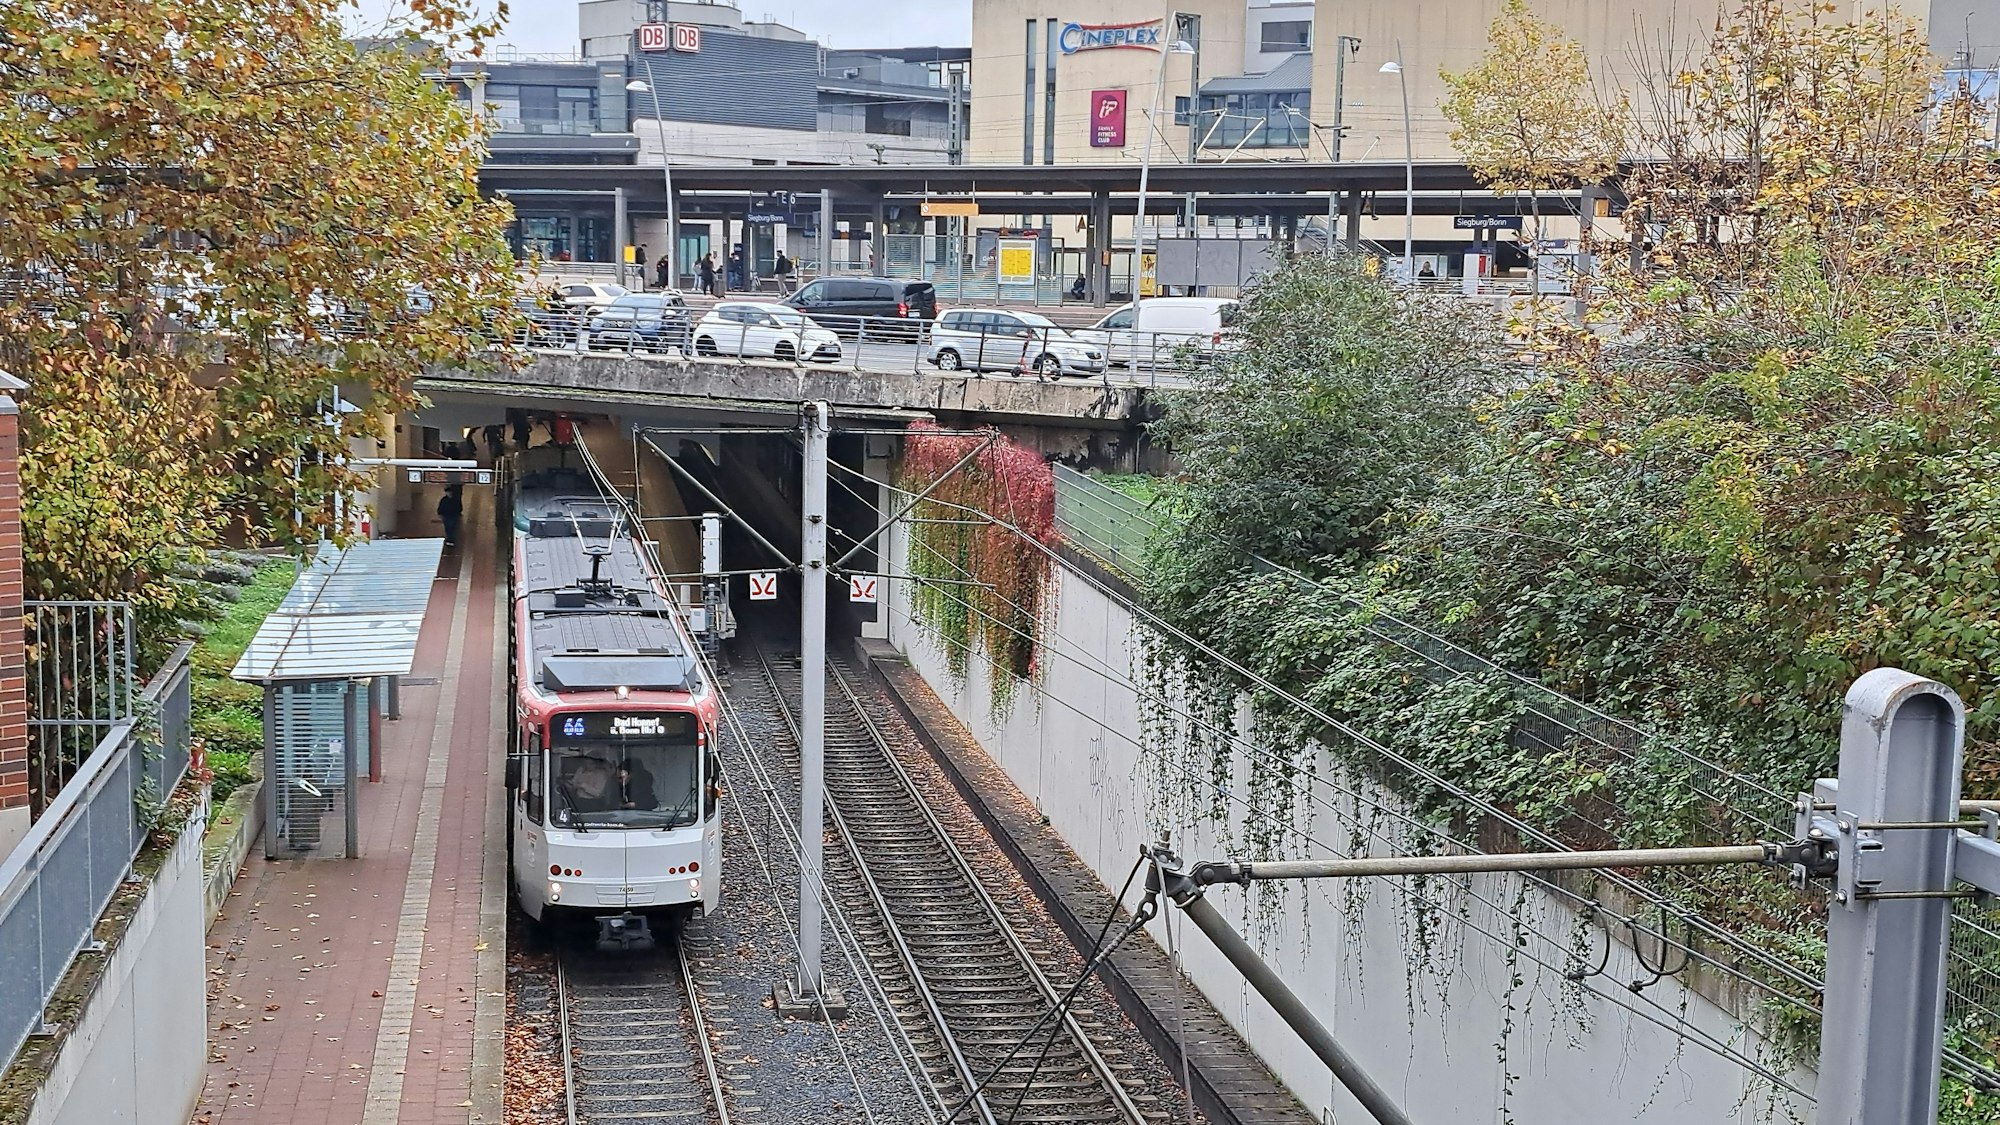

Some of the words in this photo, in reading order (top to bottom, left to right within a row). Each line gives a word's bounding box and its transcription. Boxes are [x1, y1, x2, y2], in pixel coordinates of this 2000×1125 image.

[643, 27, 664, 46] DB
[679, 28, 697, 47] DB
[1060, 23, 1160, 54] CINEPLEX
[781, 192, 787, 204] E
[790, 193, 796, 204] 6
[748, 213, 784, 222] Siegburg/Bonn
[1457, 218, 1507, 227] Siegburg/Bonn
[564, 718, 584, 735] 66
[614, 717, 631, 727] Bad
[631, 717, 660, 727] Honnef
[560, 809, 568, 822] 4
